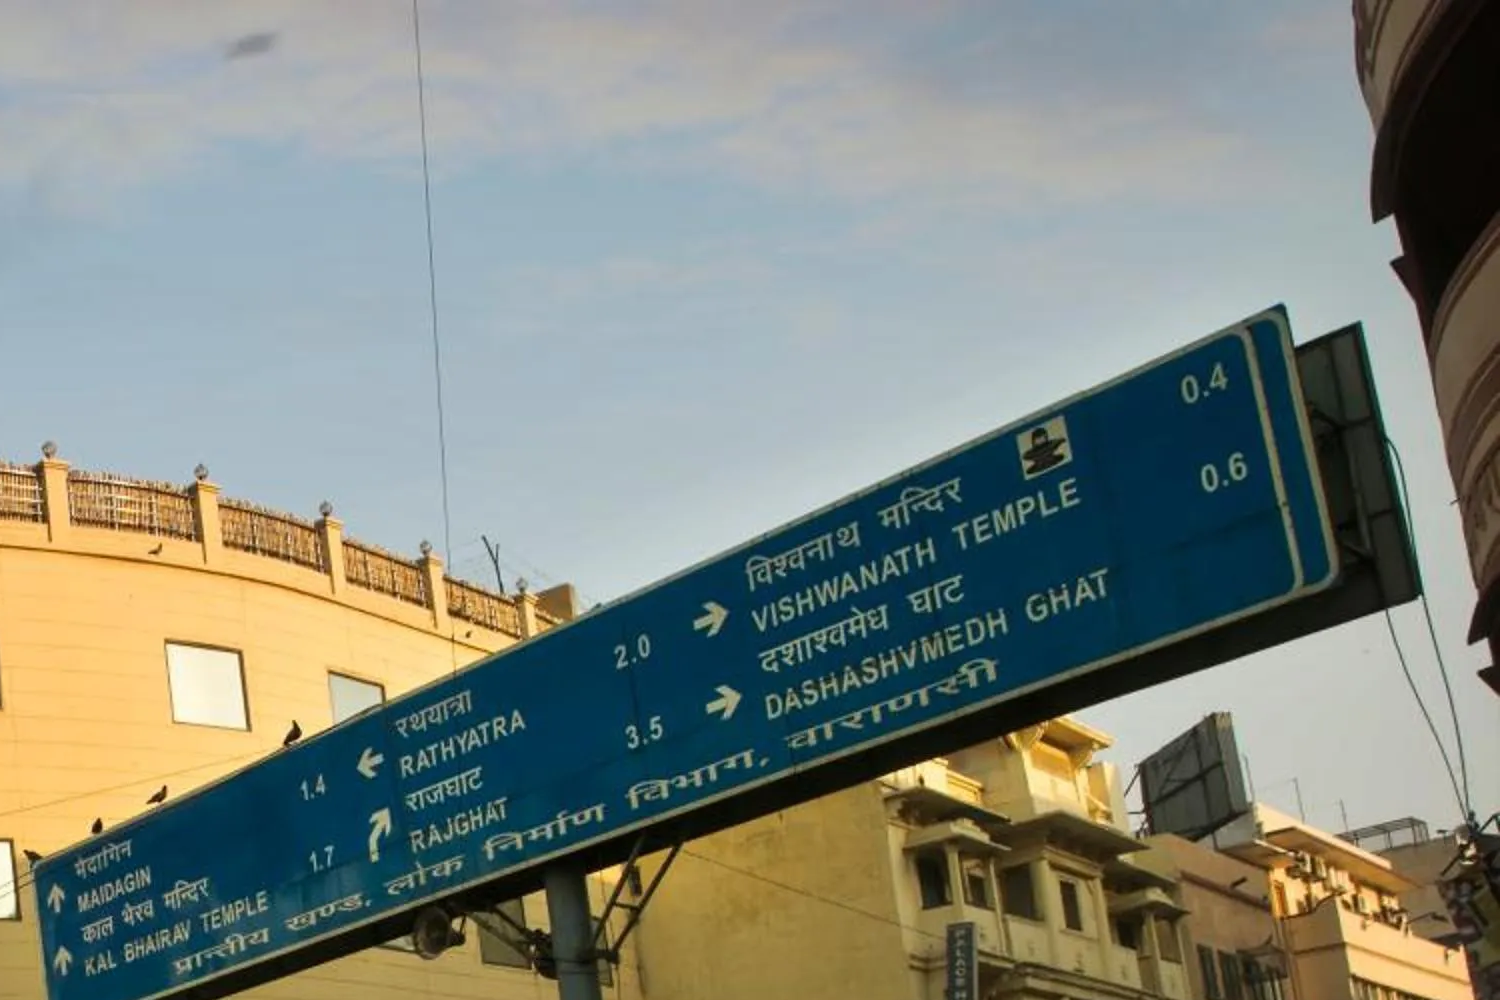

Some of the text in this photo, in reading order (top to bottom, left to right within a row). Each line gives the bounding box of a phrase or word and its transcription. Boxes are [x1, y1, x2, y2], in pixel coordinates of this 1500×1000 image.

[1180, 362, 1229, 404] 0.4
[1200, 451, 1248, 493] 0.6
[745, 477, 963, 592] विश्वनाथ मन्दिर
[751, 478, 1082, 634] VISHWANATH TEMPLE
[759, 574, 966, 675] दशाश्वमेध घाट
[764, 567, 1111, 721] DASHASHVMEDH GHAT
[613, 633, 652, 671] 2.0
[395, 689, 474, 739] रथयात्रा
[624, 715, 664, 750] 3.5
[399, 709, 527, 780] RATHYATRA
[300, 774, 327, 802] 1.4
[384, 854, 467, 898] लोक
[482, 803, 608, 861] निर्माण
[784, 658, 1001, 752] वाराणसी
[405, 766, 485, 813] राजघाट
[409, 797, 510, 854] RAJGHAT
[308, 845, 335, 874] 1.7
[76, 866, 152, 913] MAIDAGIN
[80, 915, 115, 944] काल
[162, 876, 210, 911] मन्दिर
[83, 890, 269, 978] KAL BHAIRAV TEMPLE
